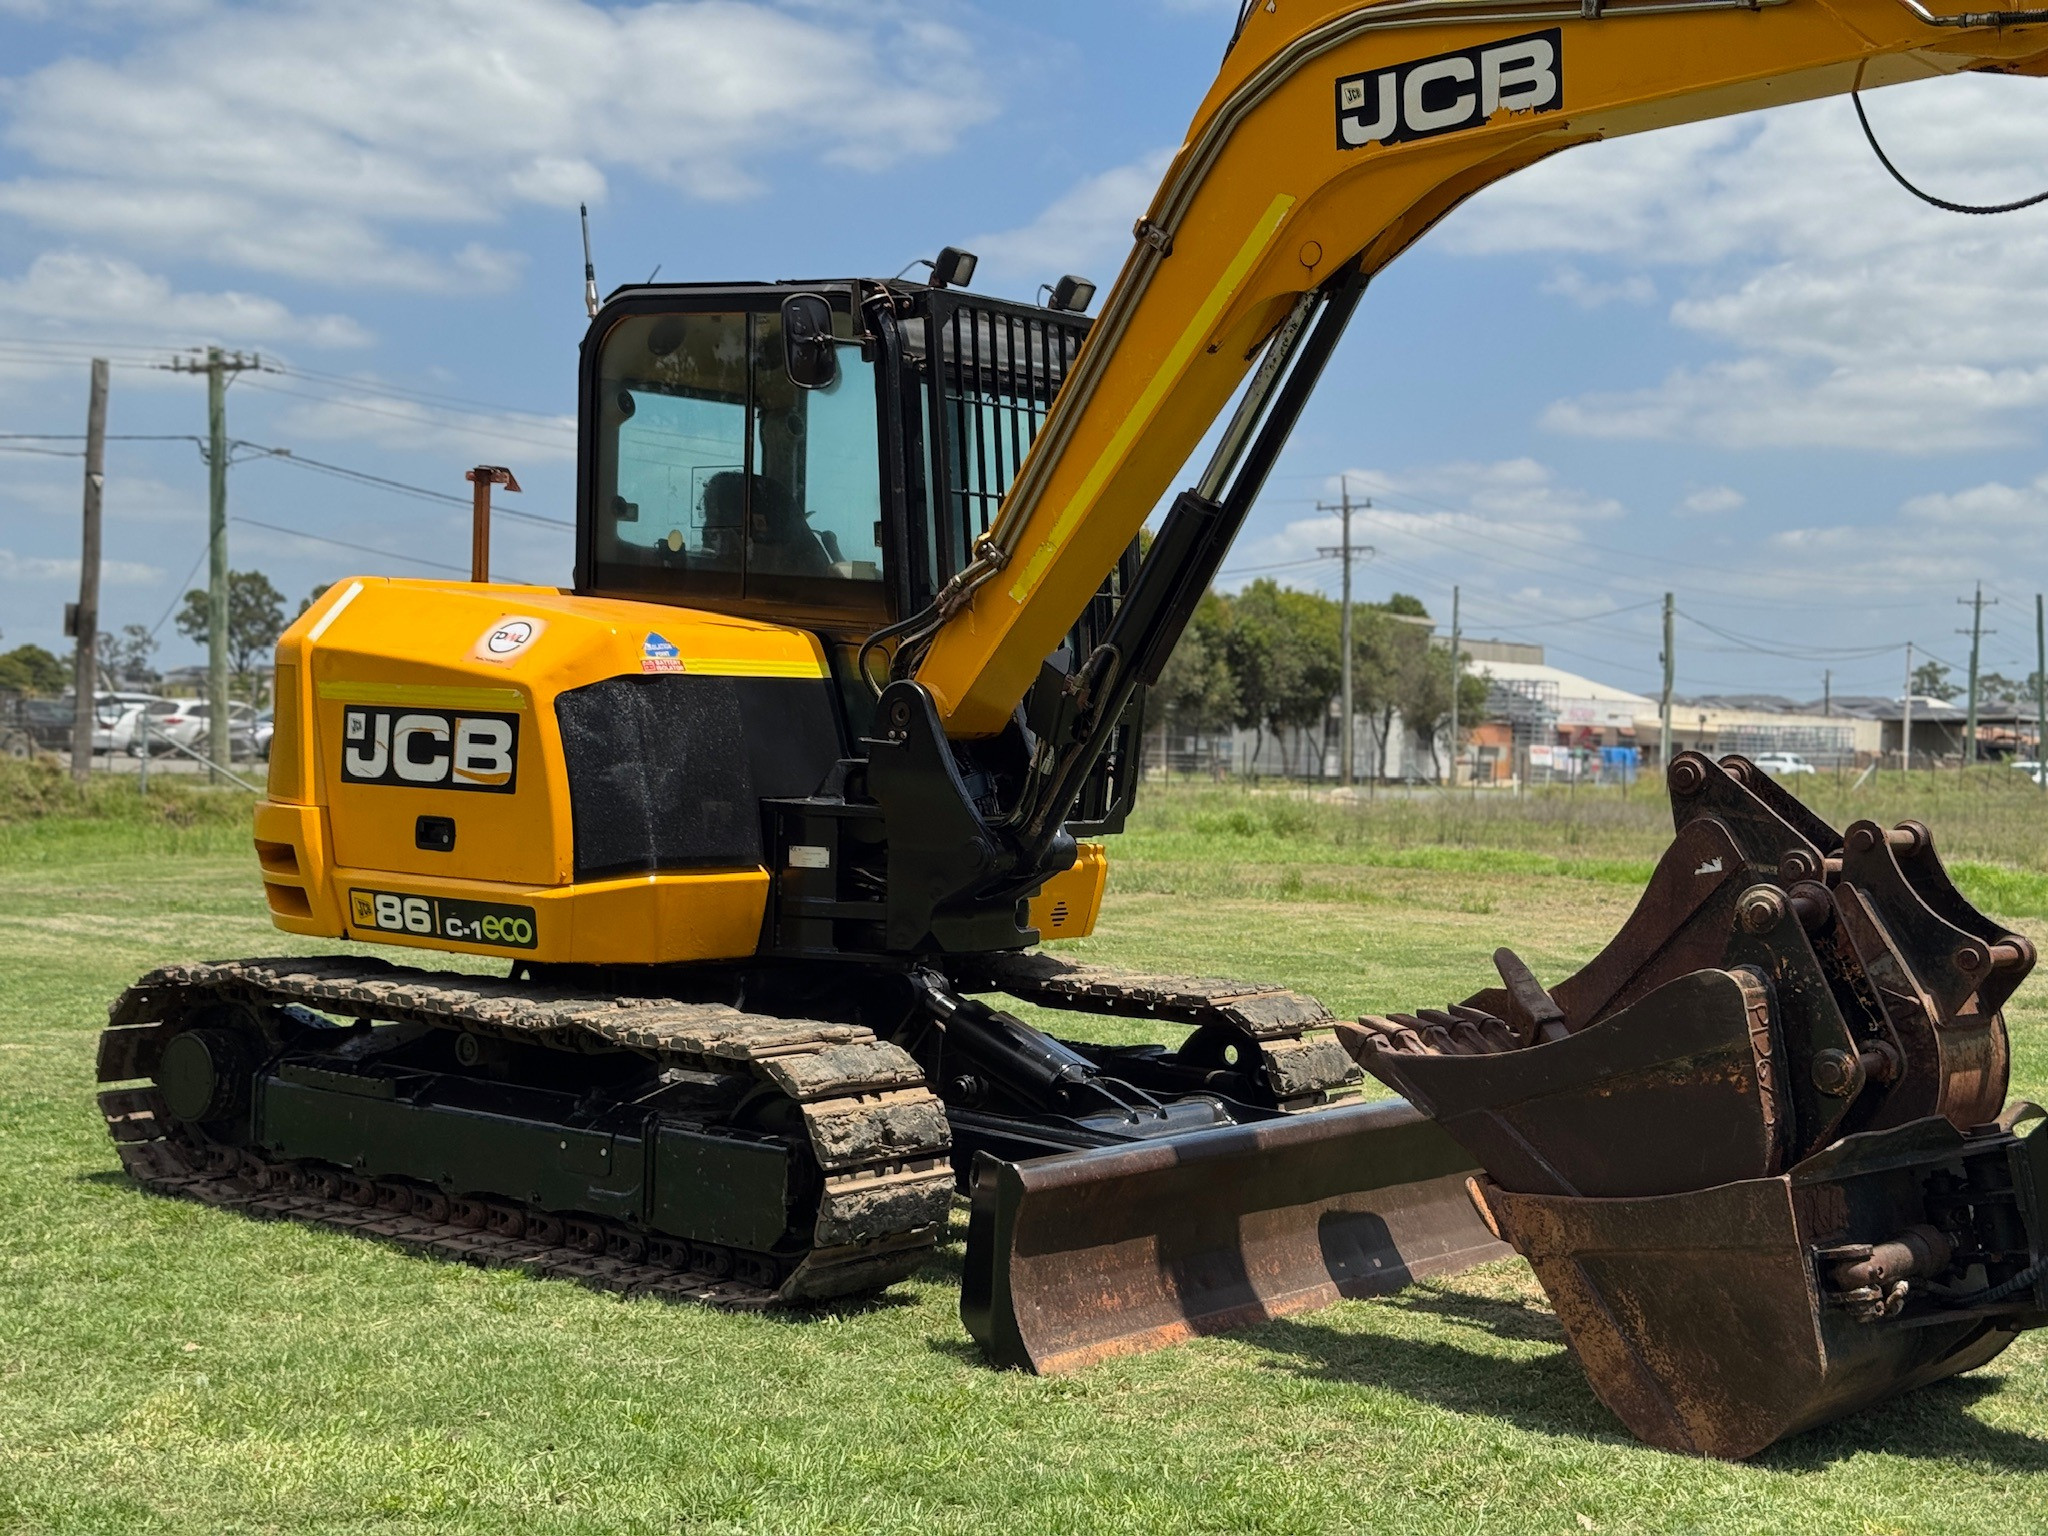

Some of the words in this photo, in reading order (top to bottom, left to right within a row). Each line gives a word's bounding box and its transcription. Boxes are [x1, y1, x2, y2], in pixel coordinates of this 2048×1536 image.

[1341, 38, 1557, 145] JCB
[345, 712, 513, 786] JCB
[374, 893, 432, 934] 86
